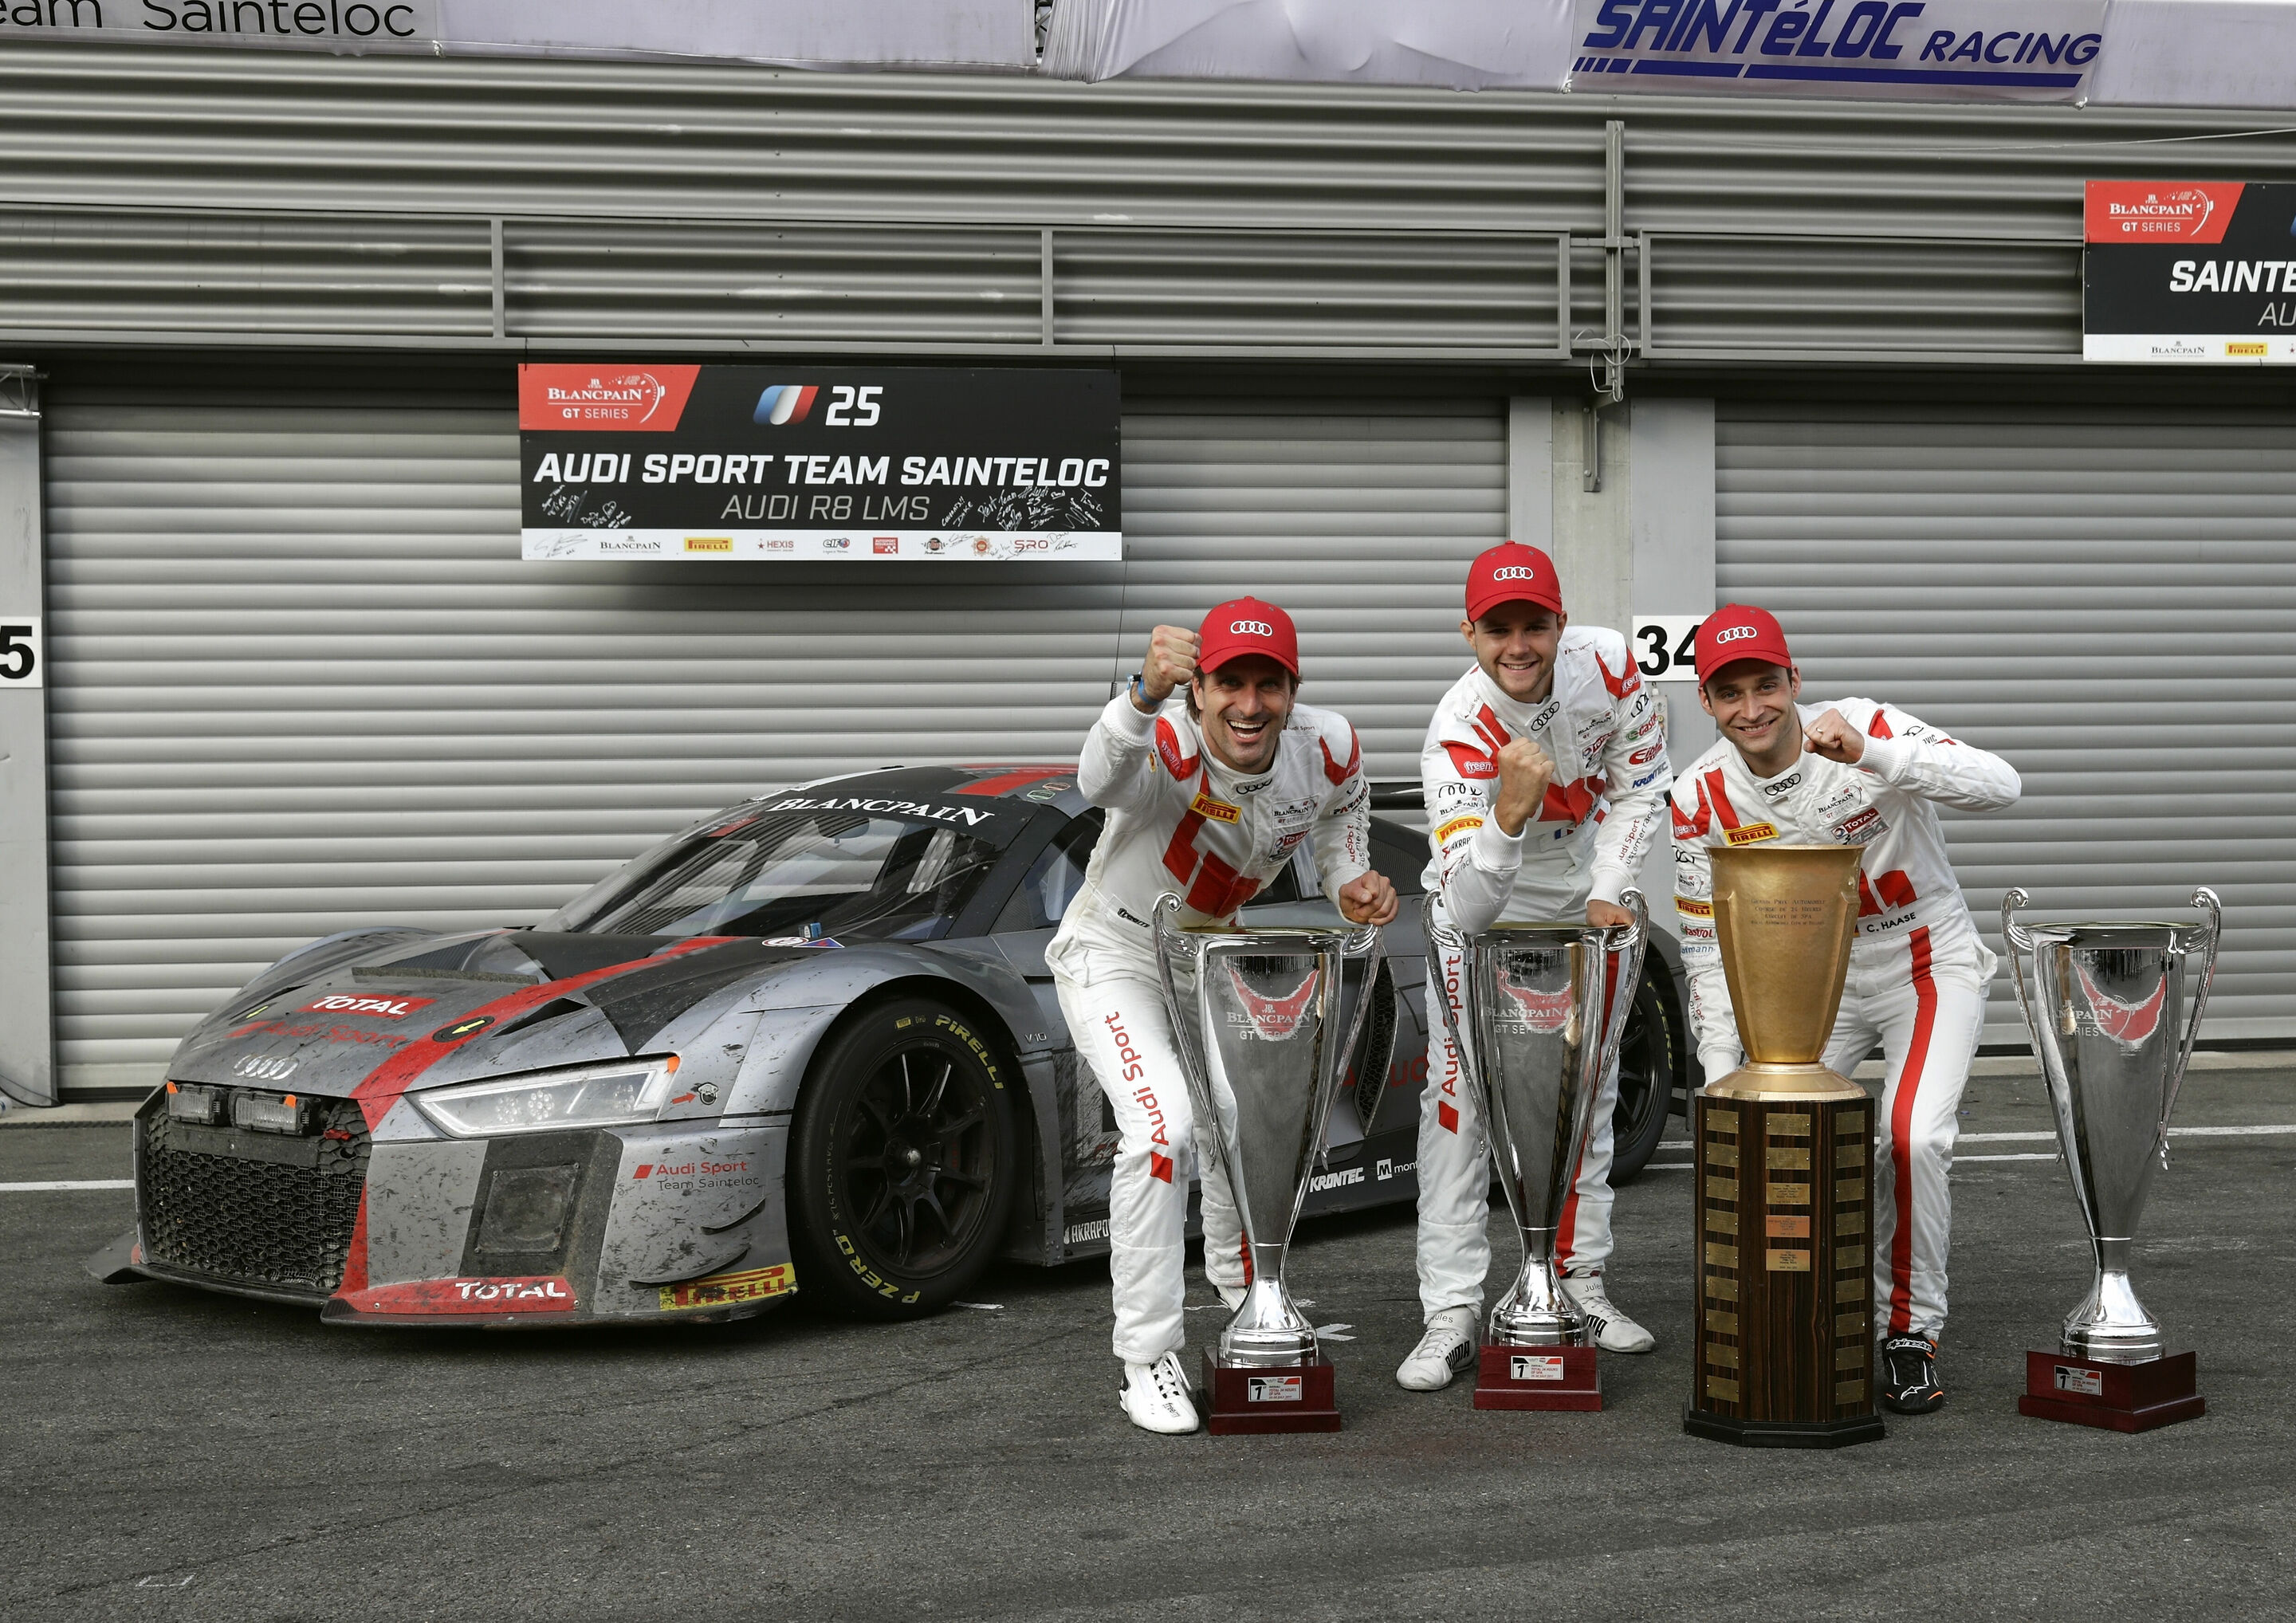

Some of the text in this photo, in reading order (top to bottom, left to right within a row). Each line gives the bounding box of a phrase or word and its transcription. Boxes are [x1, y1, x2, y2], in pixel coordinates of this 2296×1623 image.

[0, 0, 415, 37] am Sainteloc
[1920, 30, 2102, 66] RACING
[2109, 202, 2193, 215] BLANCPAIN
[2122, 222, 2180, 233] GT SERIES
[2228, 344, 2264, 354] PIRELLI
[548, 387, 643, 401] BLANCPAIN
[562, 407, 629, 419] GT SERIES
[826, 386, 883, 426] 25
[533, 453, 1110, 487] AUDI SPORT TEAM SAINTELOC
[720, 493, 800, 521] AUDI
[808, 495, 853, 521] R8
[863, 496, 930, 521] LMS
[688, 540, 729, 550] PIRELLI
[767, 540, 794, 548] HEXIS
[1014, 540, 1048, 549] SRO
[0, 625, 35, 679] 5
[766, 798, 994, 826] BLANCPAIN
[1818, 792, 1854, 813] BLANCPAIN
[1845, 812, 1876, 829] TOTAL
[1451, 835, 1473, 851] AKRAP
[1728, 825, 1773, 843] PIRELLI
[1618, 845, 1630, 860] udi
[1626, 830, 1645, 868] ustomer
[1677, 899, 1711, 915] PIRELLI
[1866, 912, 1917, 933] C. HAASE
[313, 995, 409, 1015] TOTAL
[259, 1021, 407, 1049] Audi Sport
[1240, 1030, 1256, 1040] GT
[934, 1014, 1005, 1089] PIRELLI
[1104, 1011, 1170, 1146] Audi Sport
[656, 1161, 748, 1176] Audi Sport
[657, 1176, 760, 1191] Team Sainteloc
[1309, 1166, 1365, 1193] KRONTEC
[1071, 1218, 1111, 1244] AKRAPO
[455, 1281, 567, 1300] TOTAL
